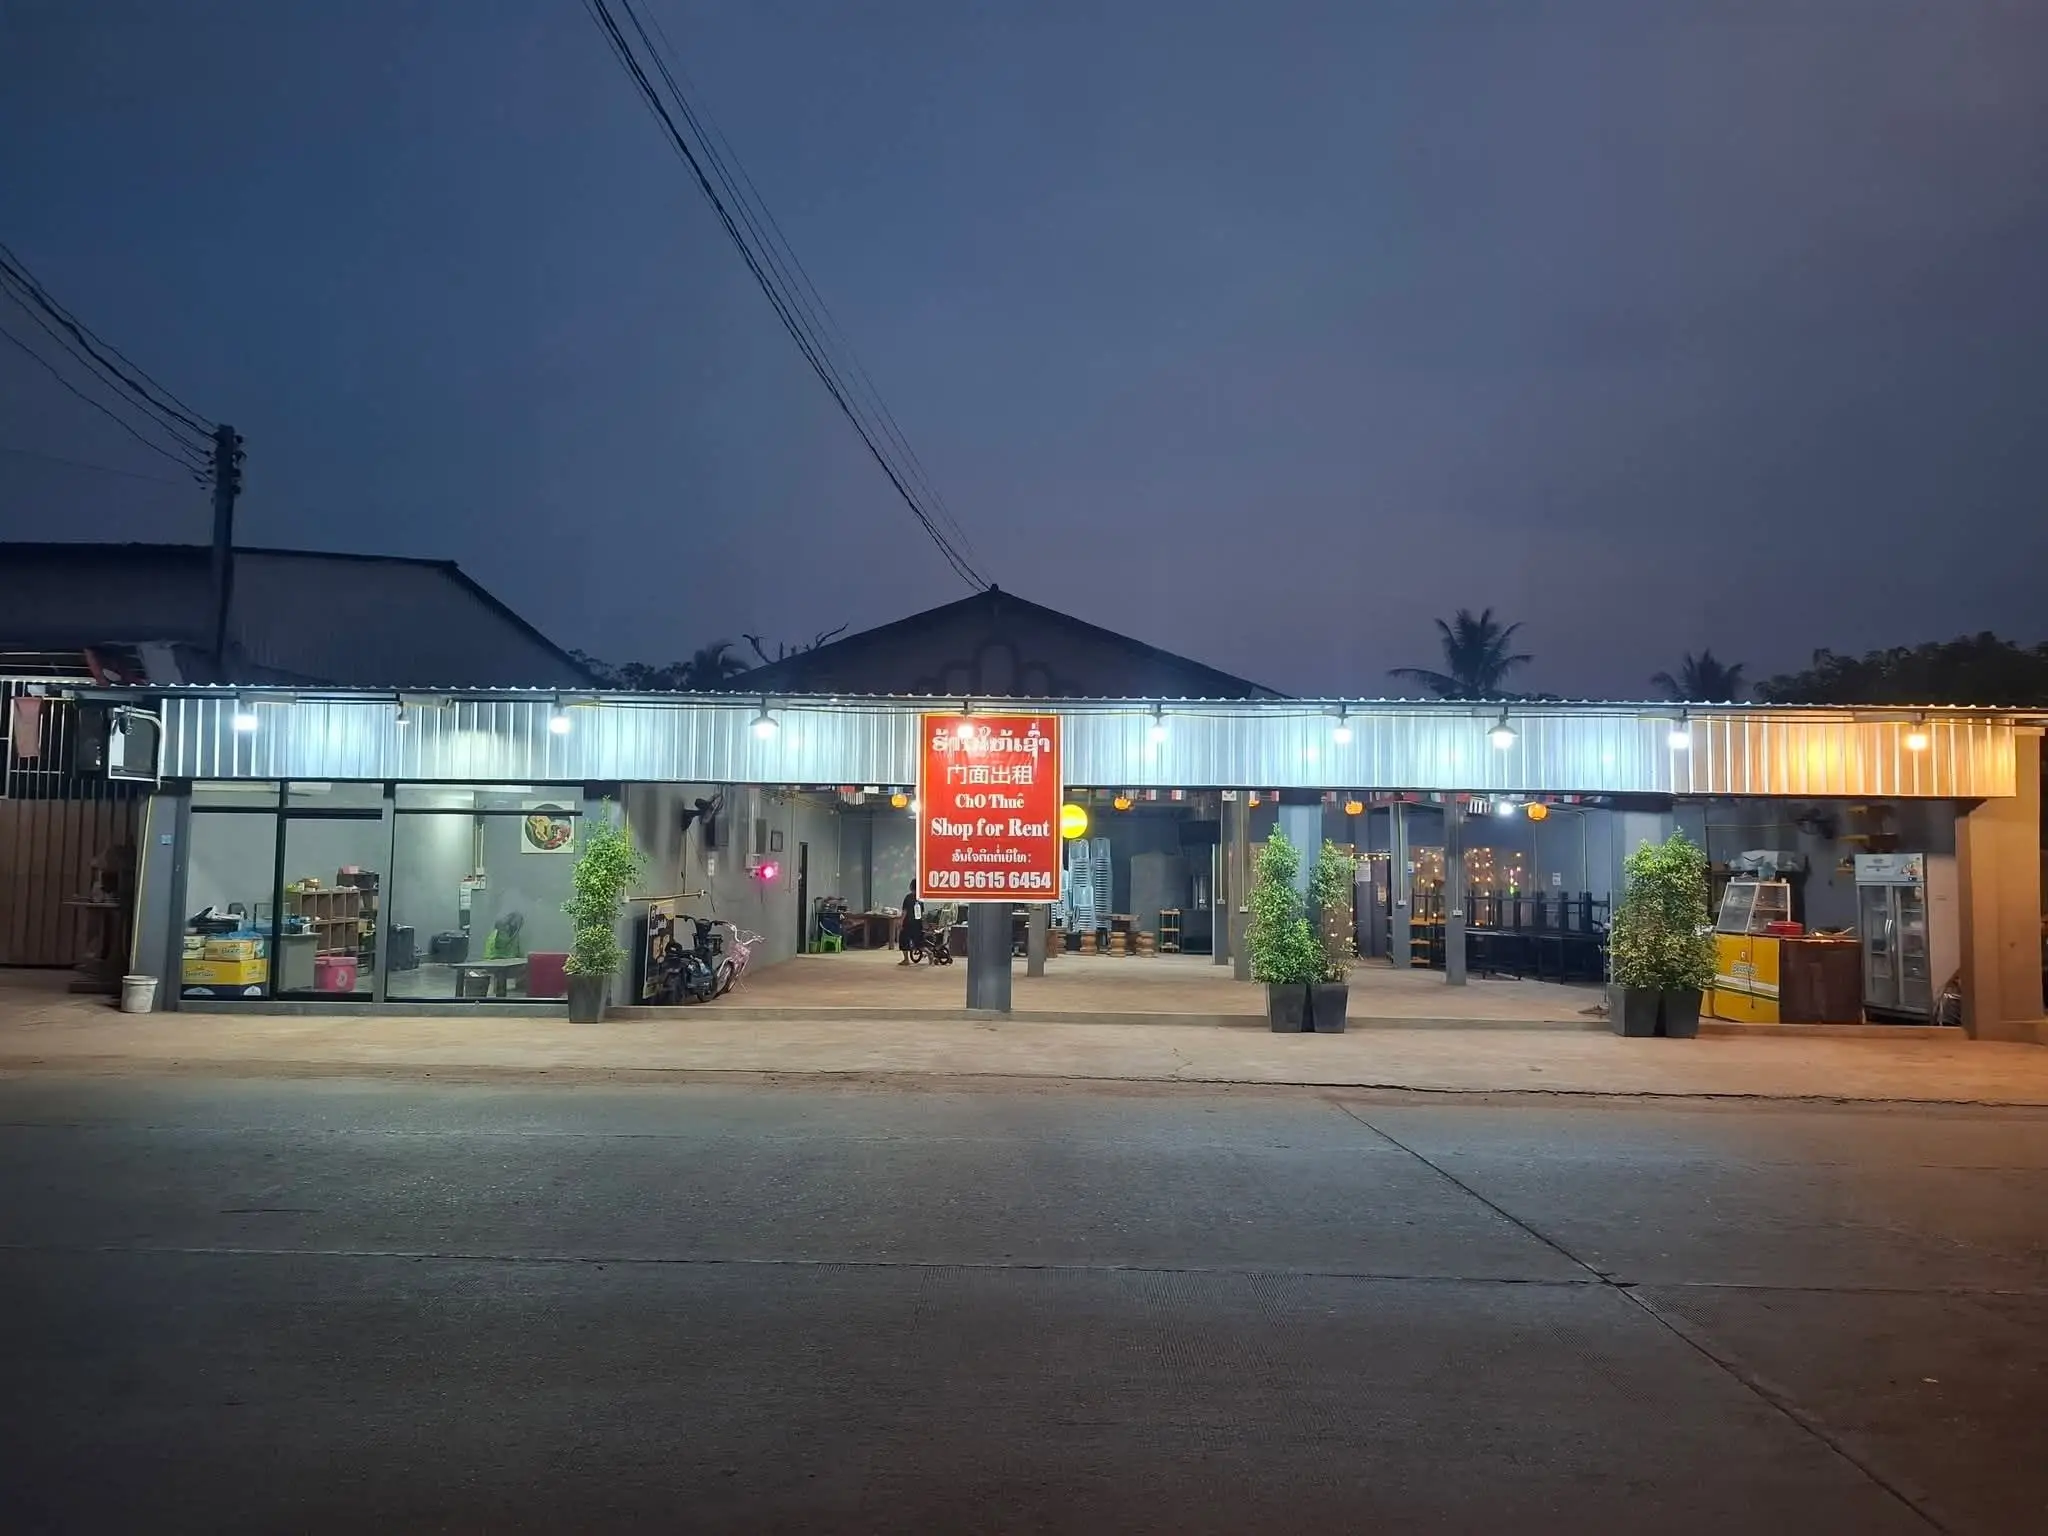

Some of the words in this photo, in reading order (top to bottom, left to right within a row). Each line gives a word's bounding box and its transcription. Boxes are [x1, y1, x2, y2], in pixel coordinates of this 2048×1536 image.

[947, 764, 1034, 785] 门面出租
[988, 792, 1025, 809] Thuê
[931, 817, 973, 841] Shop
[976, 818, 1005, 837] for
[1008, 818, 1050, 837] Rent
[928, 871, 960, 888] 020
[964, 871, 1005, 889] 5615
[1008, 871, 1051, 889] 6454
